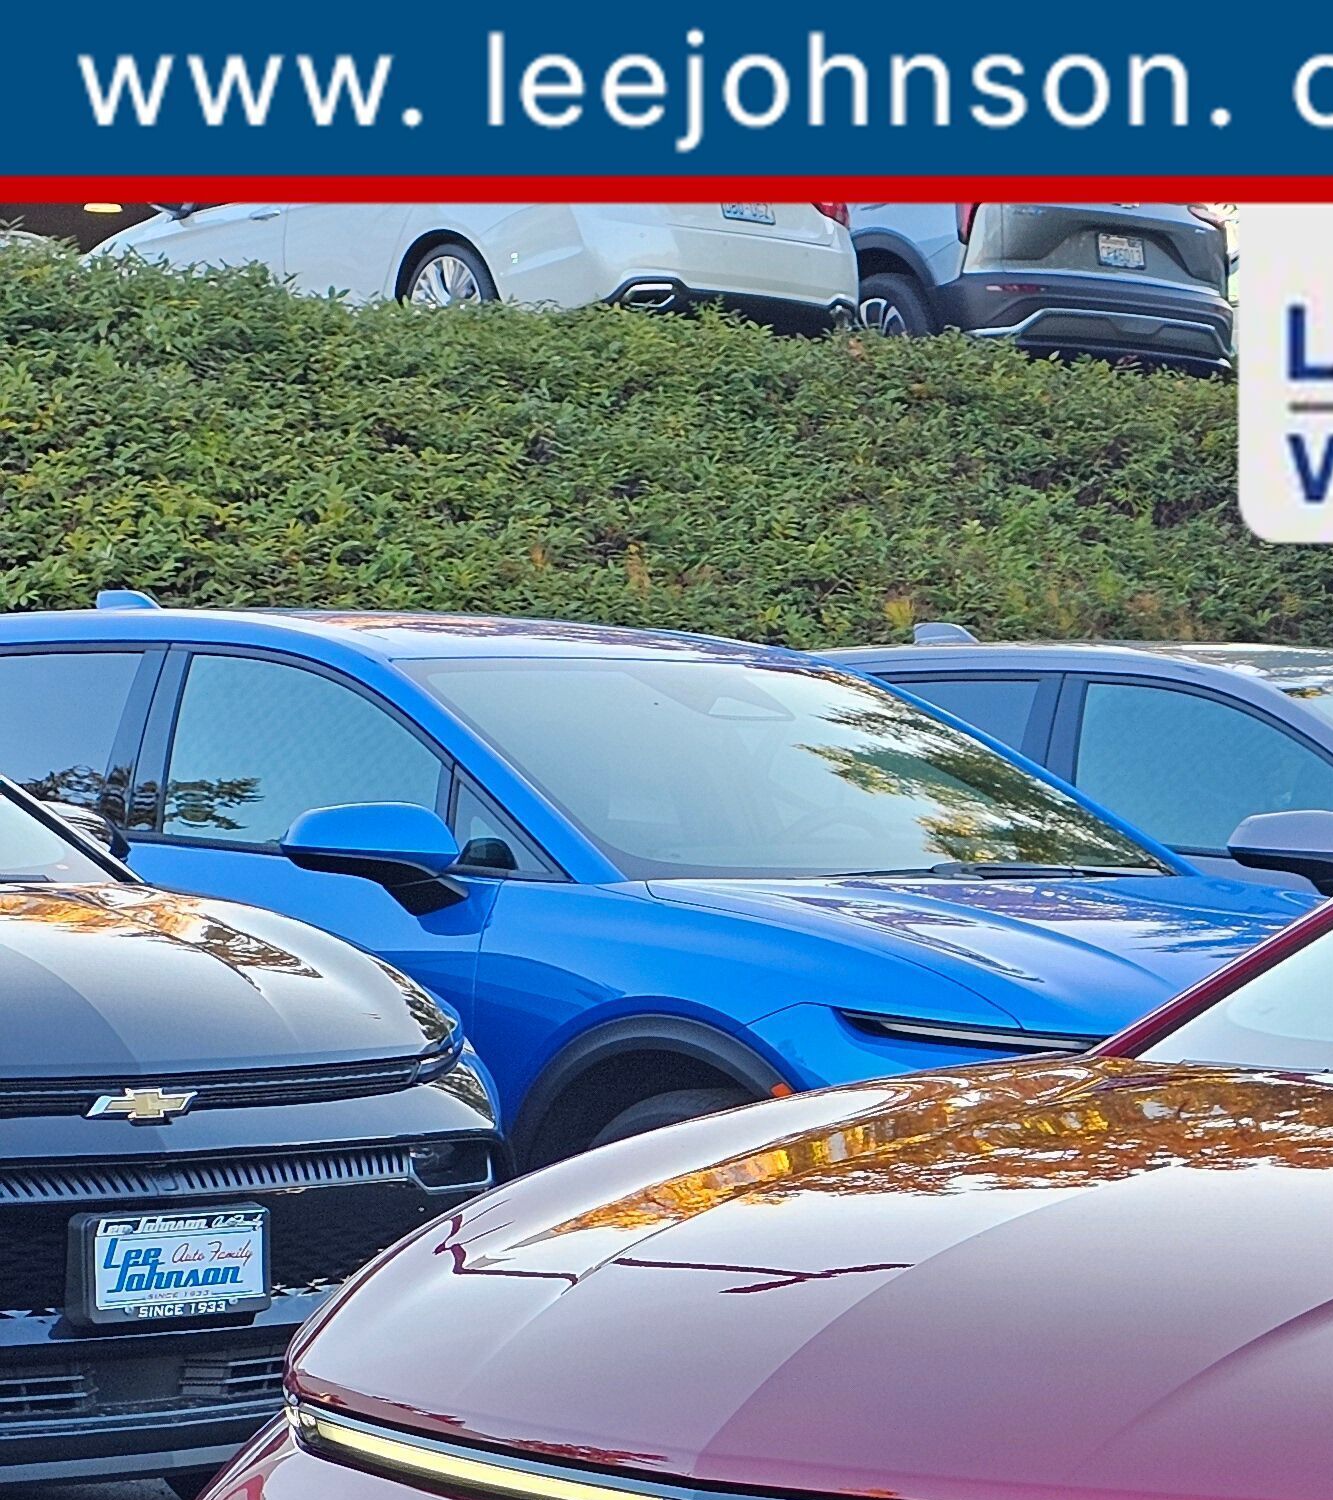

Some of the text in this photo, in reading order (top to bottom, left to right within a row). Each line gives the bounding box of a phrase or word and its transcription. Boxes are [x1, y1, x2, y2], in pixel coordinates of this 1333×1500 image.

[133, 1215, 208, 1234] Johnson
[104, 1238, 163, 1269] Lee
[172, 1240, 253, 1266] Auto Family
[107, 1258, 243, 1294] Johnson
[138, 1301, 226, 1318] SINCE 1933
